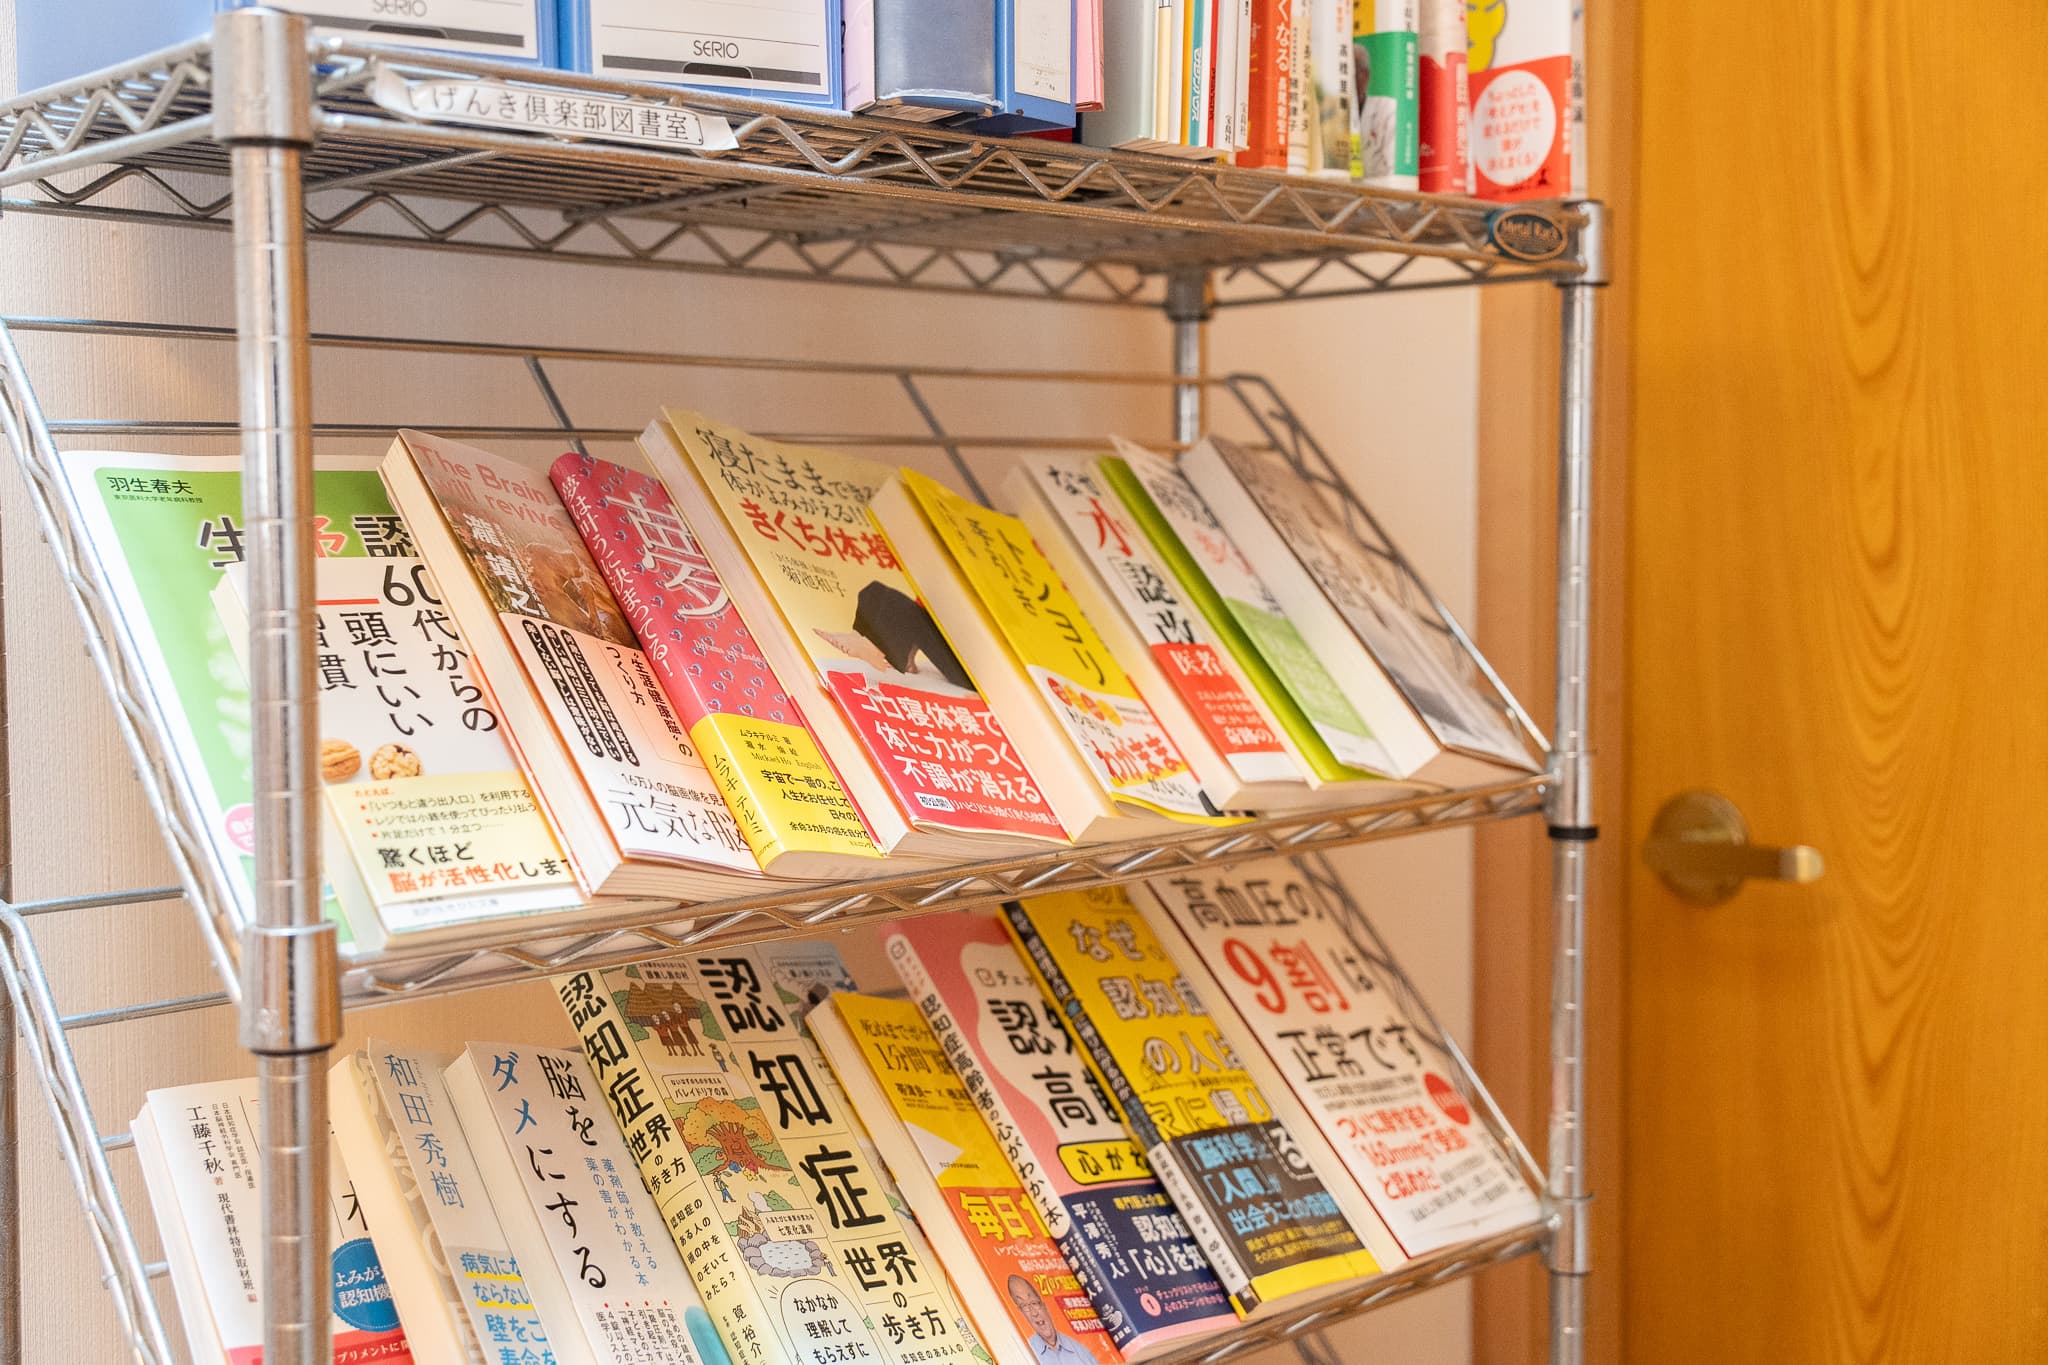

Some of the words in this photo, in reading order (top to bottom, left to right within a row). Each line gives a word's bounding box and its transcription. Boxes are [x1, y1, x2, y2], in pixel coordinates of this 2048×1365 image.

[372, 0, 428, 17] SERIO
[693, 39, 739, 60] SERIO
[107, 477, 194, 495] 羽生春夫
[410, 444, 471, 480] The
[475, 463, 549, 506] Brain
[485, 494, 562, 531] revive
[739, 497, 902, 571] きくち体操
[605, 491, 729, 620] 夢
[340, 611, 433, 736] 頭にいい
[606, 646, 646, 706] つくり方
[874, 719, 1023, 772] 体に力がつく
[893, 754, 1042, 805] 不調が消える
[377, 841, 475, 869] 驚くほど
[1170, 877, 1321, 930] 高血圧の
[559, 971, 653, 1128] 認知症
[1277, 1021, 1423, 1083] 正常です
[536, 1054, 598, 1146] 脳を
[699, 956, 886, 1231] 認知症
[186, 1106, 225, 1175] 工藤千秋
[384, 1054, 465, 1209] 和田秀樹
[629, 1113, 672, 1164] 世界
[491, 1051, 607, 1288] ダメにする
[650, 1156, 687, 1195] 歩き方
[584, 1156, 650, 1287] 薬の害がわかる本
[601, 1157, 658, 1270] 薬剤師が教える
[669, 1198, 703, 1230] 認知症の
[679, 1216, 711, 1247] ある人の
[217, 1192, 255, 1291] 現代書林特別取材班
[686, 1233, 721, 1265] 頭の中を
[696, 1252, 729, 1283] のぞいて
[844, 1240, 919, 1292] 世界
[793, 1293, 839, 1314] なかなか
[882, 1305, 947, 1345] 歩き方
[892, 1290, 908, 1308] の
[333, 1340, 411, 1364] プリメントに
[731, 1303, 762, 1359] 筧裕介
[804, 1318, 852, 1339] 理解して
[812, 1341, 870, 1365] もらえずに
